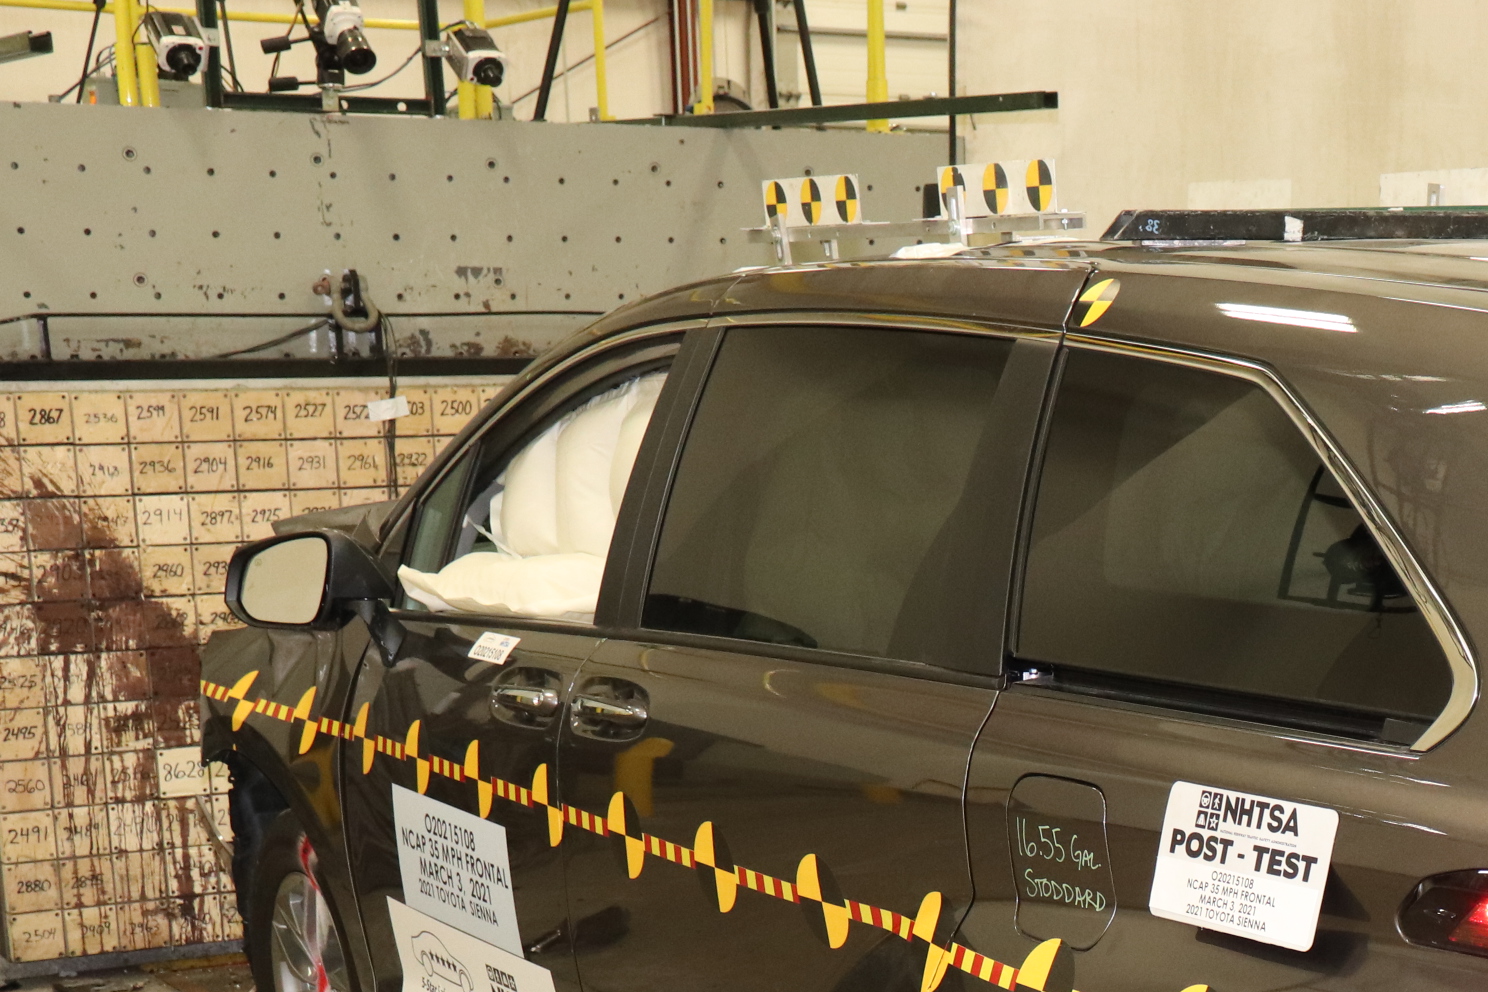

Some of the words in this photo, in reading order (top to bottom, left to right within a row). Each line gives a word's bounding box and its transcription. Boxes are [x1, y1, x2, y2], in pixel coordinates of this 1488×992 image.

[28, 407, 64, 426] 2867
[189, 406, 219, 422] 2591
[243, 405, 277, 423] 2574
[294, 403, 327, 419] 2527
[440, 400, 473, 417] 2500
[139, 460, 177, 474] 2936
[193, 456, 228, 474] 2904
[245, 456, 274, 471] 2916
[298, 455, 327, 471] 2931
[142, 508, 183, 526] 2914
[251, 507, 282, 524] 2925
[152, 563, 184, 579] 2960
[203, 560, 229, 576] 293
[3, 725, 38, 742] 2495
[6, 779, 46, 794] 2560
[1222, 795, 1299, 837] NHTSA
[8, 825, 48, 844] 2491
[1016, 816, 1066, 863] 16.55
[401, 826, 426, 854] NCAP
[429, 838, 440, 860] 35
[442, 843, 464, 870] MPH
[465, 852, 509, 890] FRONTAL
[1169, 828, 1234, 865] POST
[1252, 844, 1318, 883] TEST
[419, 856, 455, 889] MARCH
[456, 872, 466, 896] 3,
[470, 877, 492, 906] 2021
[1024, 868, 1106, 912] STODDARD
[418, 877, 436, 899] 2021
[436, 885, 468, 914] TOYOTA
[469, 900, 499, 927] SIENNA
[1186, 878, 1209, 892] NCAP
[1210, 883, 1221, 895] 35
[1221, 886, 1239, 899] MPH
[1240, 890, 1276, 908] FRONTAL
[1199, 894, 1228, 910] MARCH
[1229, 901, 1236, 913] 3,
[1238, 903, 1257, 916] 2021
[1186, 904, 1203, 917] 2021
[1205, 908, 1235, 925] TOYOTA
[1236, 915, 1267, 933] SIENNA
